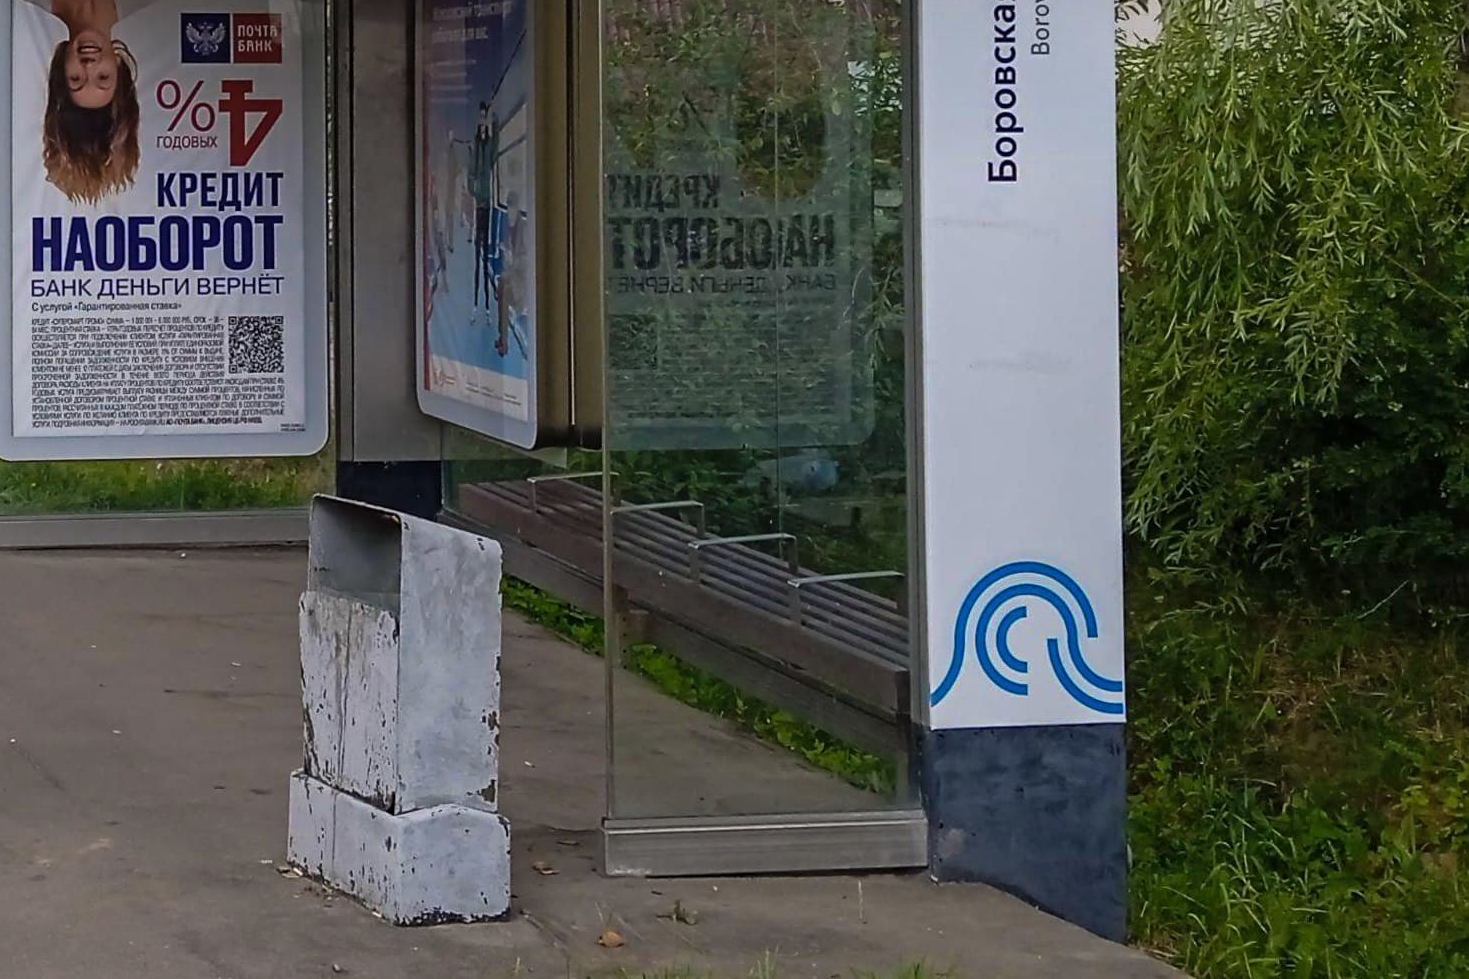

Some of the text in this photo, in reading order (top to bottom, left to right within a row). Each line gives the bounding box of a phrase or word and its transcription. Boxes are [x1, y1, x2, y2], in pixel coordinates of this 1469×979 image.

[237, 24, 278, 38] ПОЧТА
[237, 39, 273, 52] БАНК
[156, 135, 218, 150] ГОДОВЫХ
[156, 172, 284, 212] КРЕДИТ
[31, 214, 284, 272] НАОБОРОТ
[31, 273, 285, 300] БАНК ДЕНЬГИ ВЕРНЁТ
[31, 302, 39, 312] С
[40, 301, 73, 313] услугой
